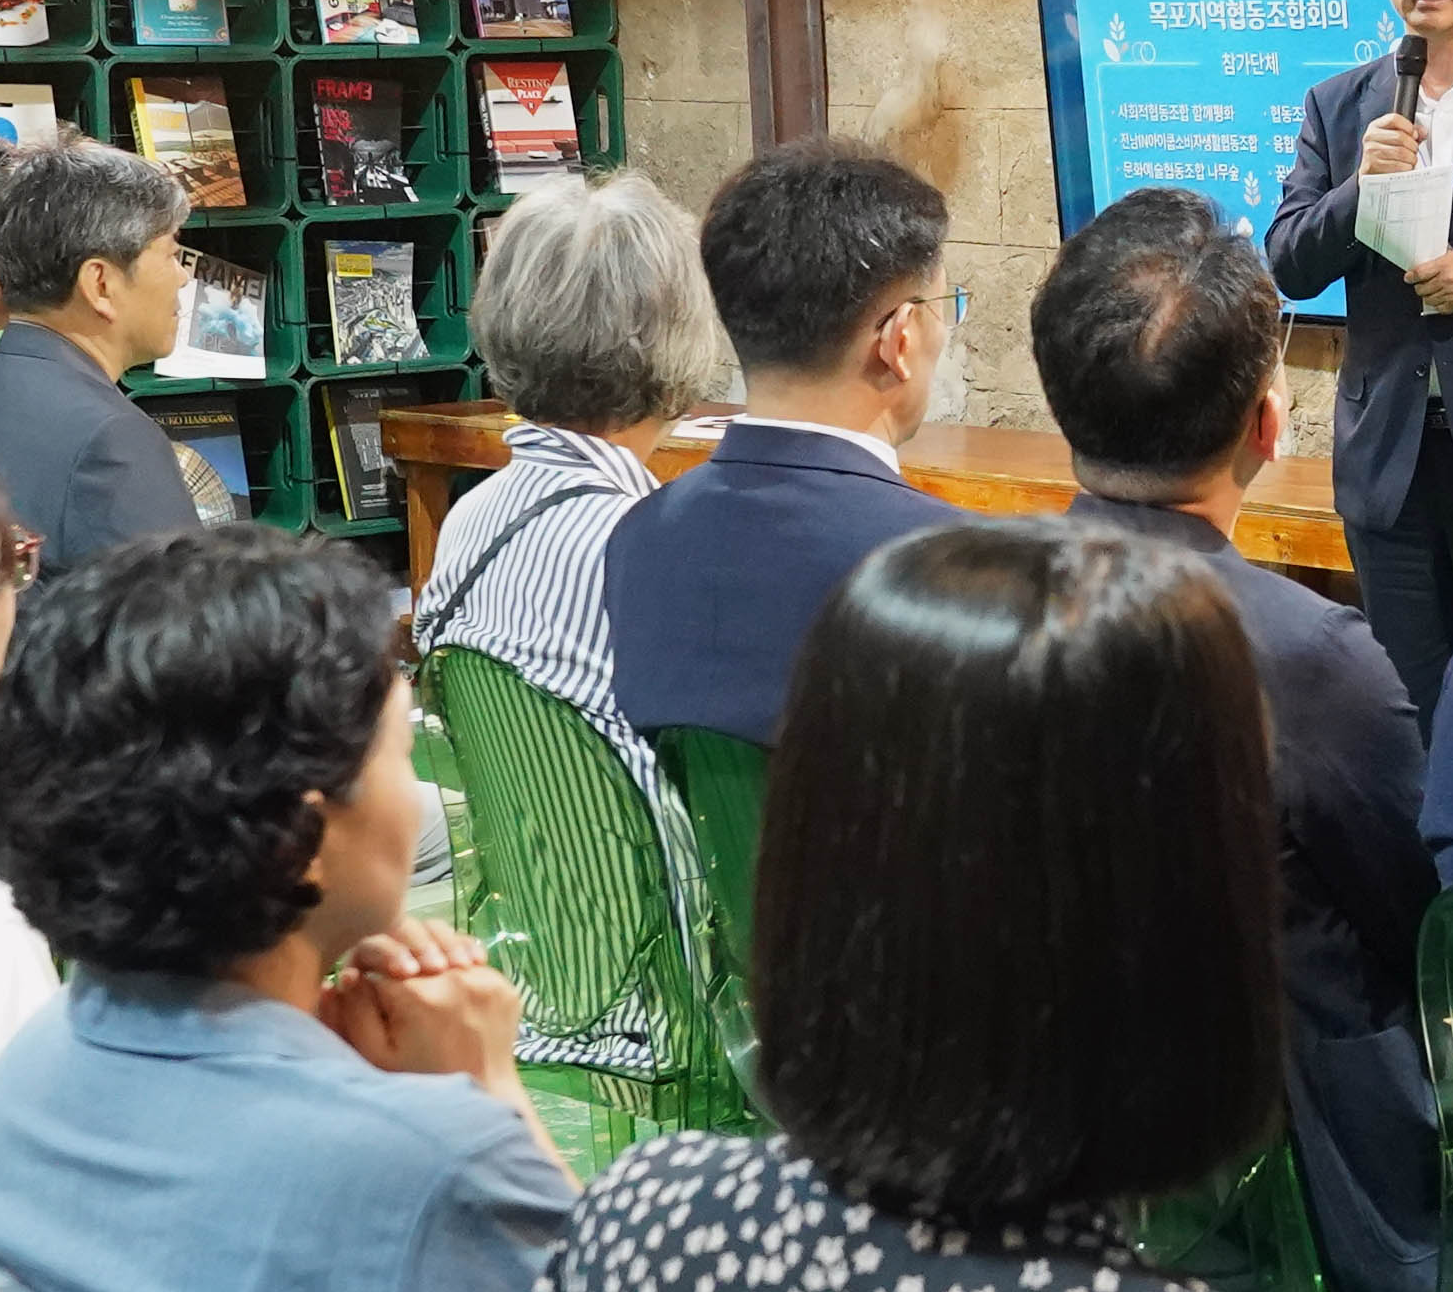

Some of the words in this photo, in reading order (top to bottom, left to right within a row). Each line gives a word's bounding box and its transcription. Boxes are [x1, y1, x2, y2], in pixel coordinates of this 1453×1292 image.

[1221, 51, 1280, 76] 참가단체
[507, 76, 551, 89] RESTING
[516, 89, 543, 100] PLACE
[1118, 103, 1190, 122] 사회적협동조합
[1191, 104, 1235, 123] 함께평화
[1122, 160, 1205, 181] 문화예술협동조합
[1207, 163, 1240, 183] 나무숲
